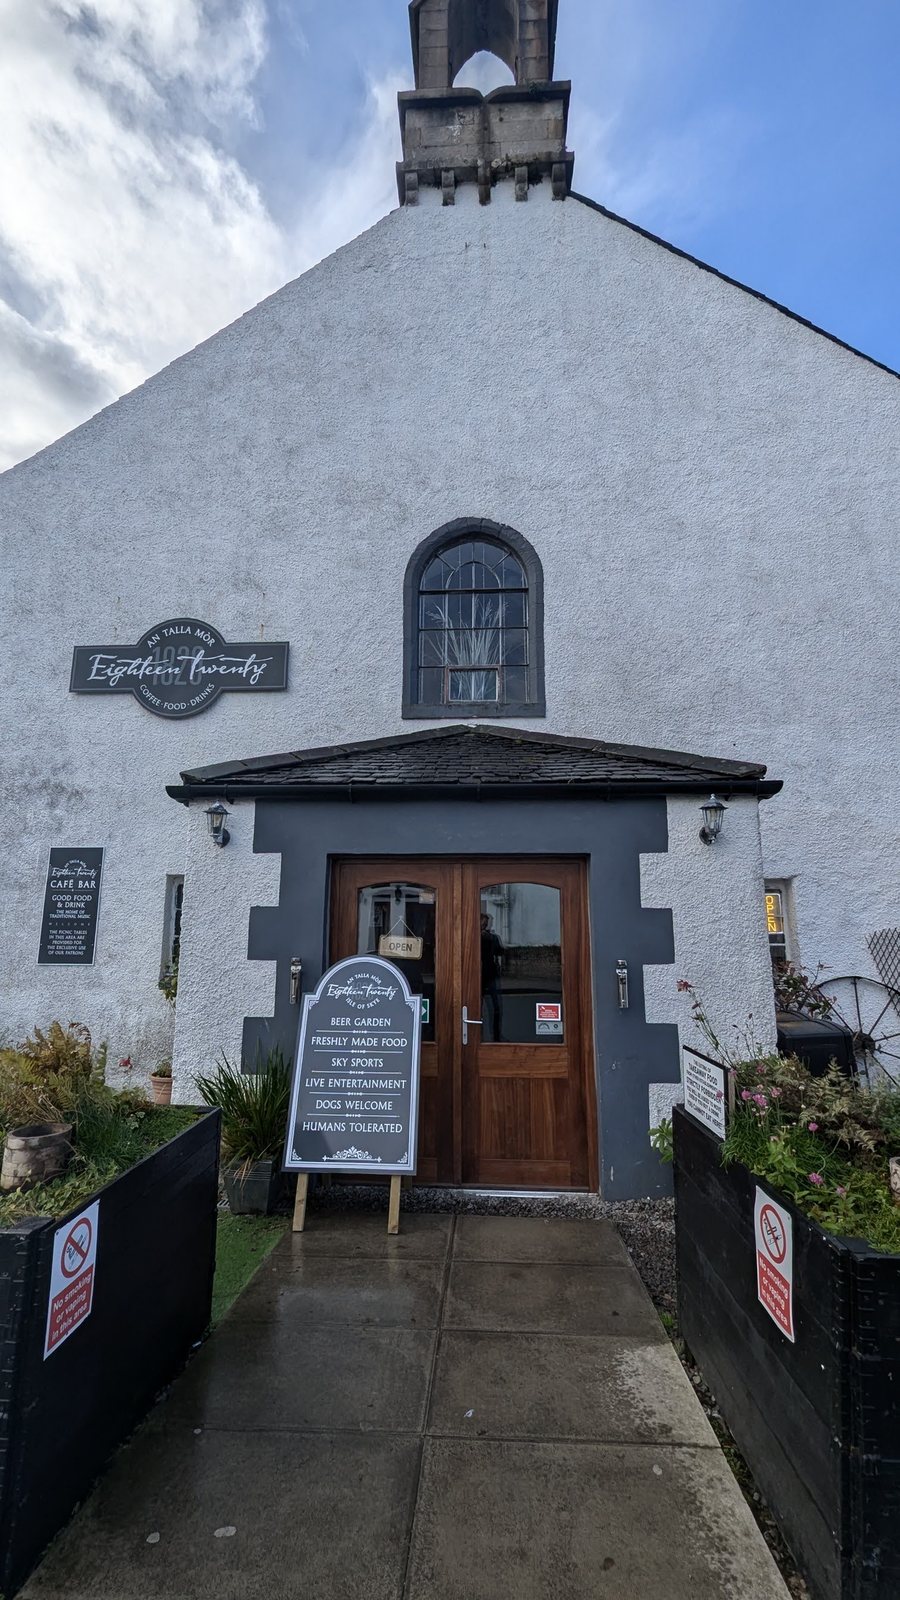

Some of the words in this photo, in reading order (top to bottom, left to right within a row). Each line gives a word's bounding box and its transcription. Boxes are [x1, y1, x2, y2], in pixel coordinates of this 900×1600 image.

[147, 633, 161, 648] AN
[162, 626, 191, 638] TALLA
[194, 630, 216, 647] MÒR
[87, 654, 180, 686] Eighteen
[139, 684, 161, 707] COFFEE
[163, 702, 187, 710] FOOD
[190, 683, 216, 706] DRINKS
[52, 868, 75, 878] Eighteen
[78, 880, 96, 888] BAR
[766, 896, 776, 932] OPEN
[389, 942, 412, 951] OPEN
[327, 984, 363, 999] Eighteen
[346, 998, 356, 1007] ISLE
[367, 998, 380, 1008] SKYE
[331, 1017, 351, 1026] BEER
[354, 1018, 391, 1026] GARDEN
[311, 1037, 348, 1046] FRESHLY
[352, 1038, 378, 1046] MADE
[382, 1038, 408, 1047] FOOD
[331, 1058, 348, 1067] SKY
[351, 1058, 384, 1067] SPORTS
[306, 1078, 325, 1087] LIVE
[328, 1078, 407, 1089] ENTERTAINMENT
[707, 1073, 717, 1086] FOOD
[316, 1100, 341, 1110] DOGS
[345, 1101, 392, 1110] WELCOME
[303, 1122, 346, 1131] HUMANS
[349, 1123, 402, 1133] TOLERATED
[760, 1258, 766, 1271] No
[767, 1268, 788, 1299] smoking
[53, 1299, 63, 1312] No
[65, 1274, 91, 1302] smoking
[763, 1277, 768, 1285] or
[769, 1283, 785, 1310] vaping
[56, 1312, 64, 1323] or
[66, 1291, 86, 1314] vaping
[766, 1293, 775, 1310] this
[775, 1306, 788, 1326] area
[52, 1330, 58, 1342] in
[60, 1316, 72, 1334] this
[74, 1302, 87, 1320] area
